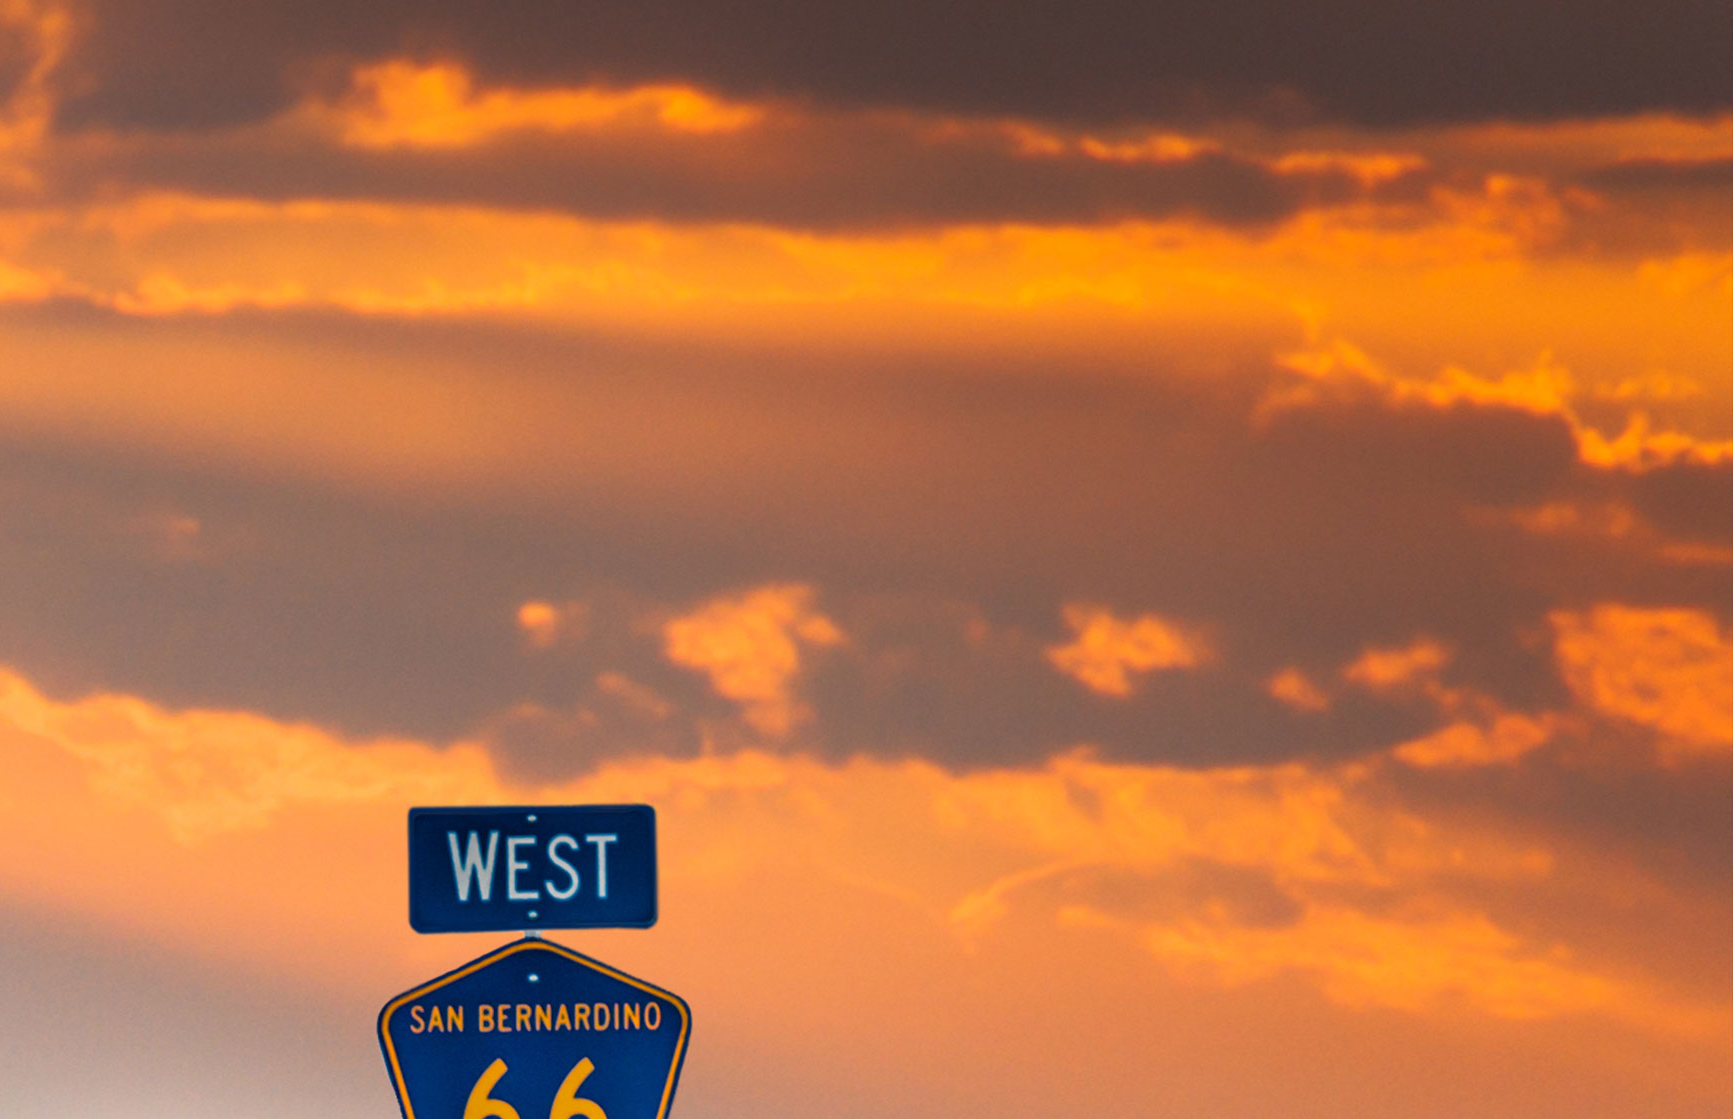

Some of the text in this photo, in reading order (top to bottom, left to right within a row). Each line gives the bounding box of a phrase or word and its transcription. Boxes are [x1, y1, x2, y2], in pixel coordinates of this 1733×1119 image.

[448, 831, 617, 900] WEST
[409, 1002, 661, 1033] SAN BERNARDINO
